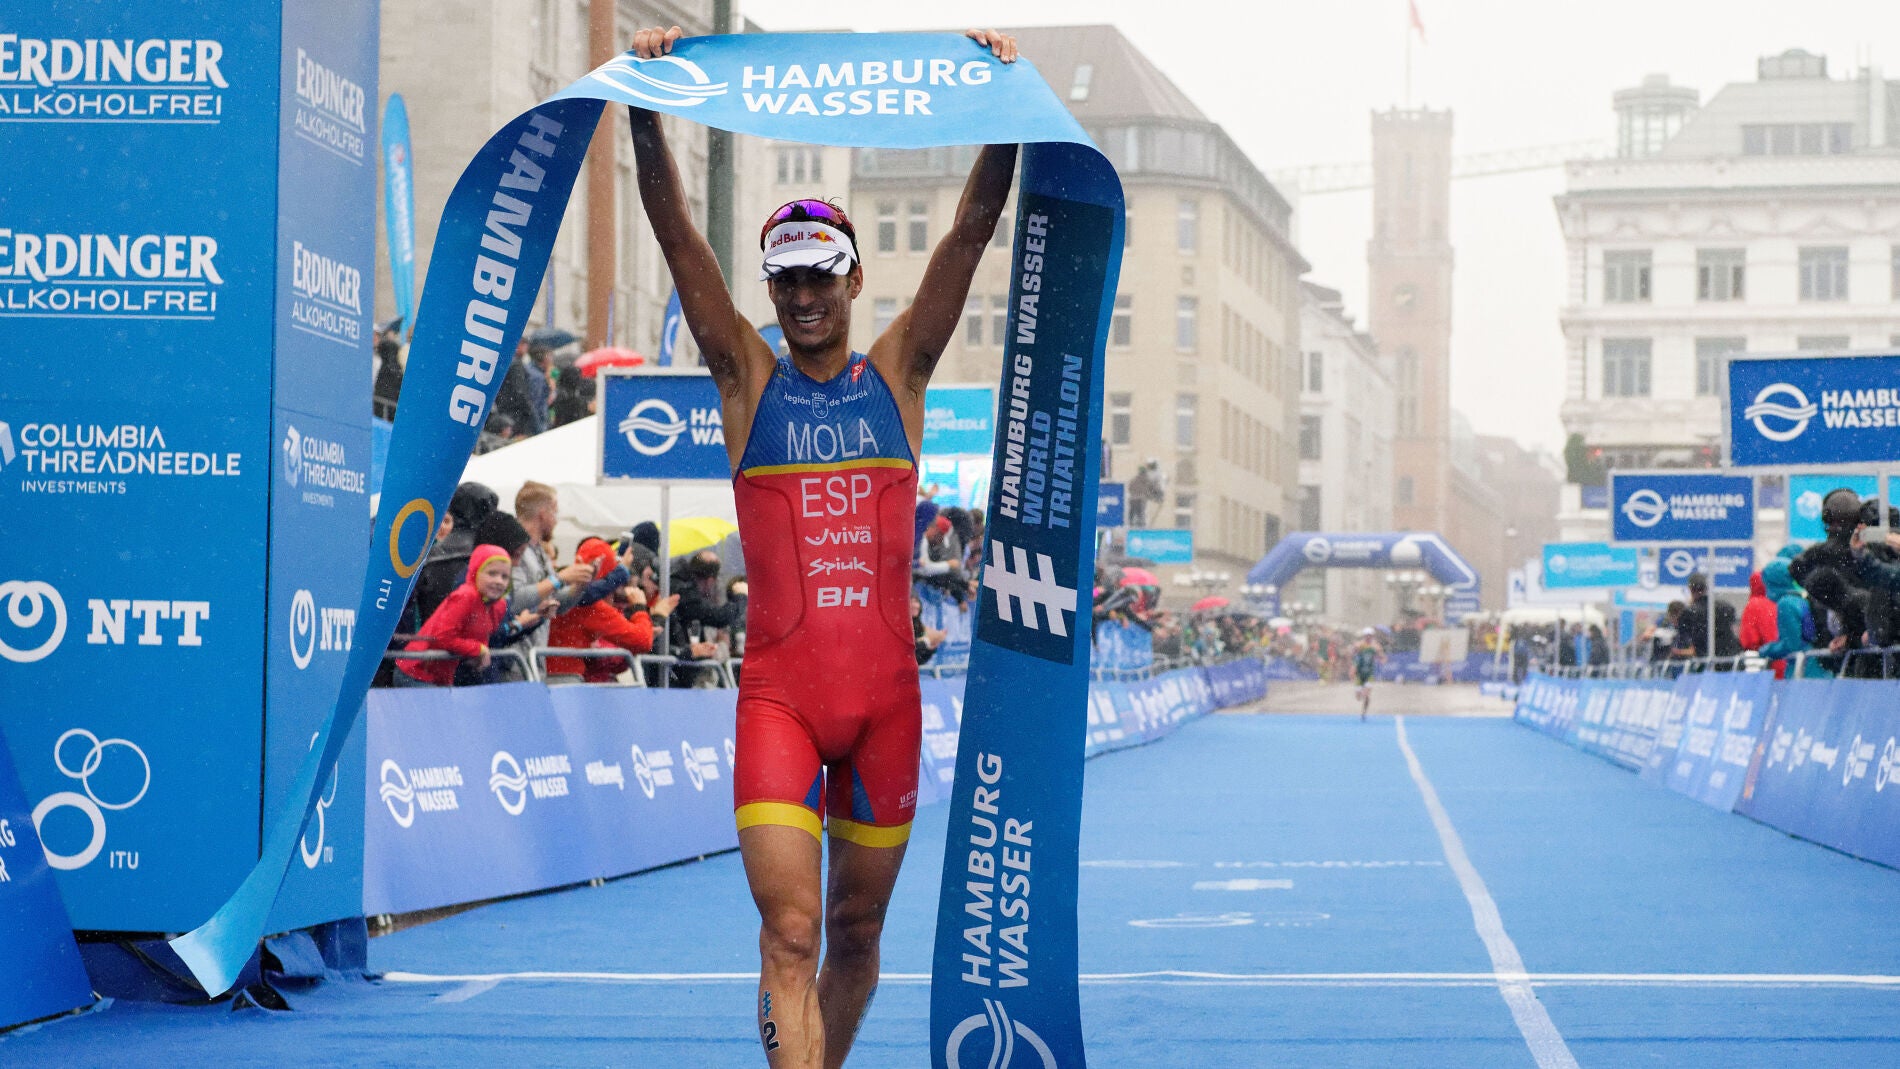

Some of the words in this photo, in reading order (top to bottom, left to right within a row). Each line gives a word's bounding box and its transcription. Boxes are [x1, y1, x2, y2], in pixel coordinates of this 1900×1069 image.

[0, 34, 229, 88] ERDINGER
[742, 59, 992, 89] HAMBURG
[296, 47, 365, 134] ERDINGER
[742, 89, 933, 116] WASSER
[295, 107, 364, 158] ALKOHOLFREI
[783, 231, 804, 243] Bull
[293, 240, 362, 316] ERDINGER
[449, 112, 565, 428] HAMBURG
[1016, 213, 1049, 344] WASSER
[0, 288, 216, 312] LKOHOLFREI
[292, 301, 360, 340] ALKOHOLFREI
[829, 398, 840, 407] de
[1823, 408, 1900, 429] WASSE
[21, 424, 166, 449] COLUMBIA
[302, 435, 346, 467] COLUMBIA
[787, 417, 879, 461] MOLA
[1000, 353, 1033, 520] HAMBURG
[1048, 353, 1083, 529] TRIATHLON
[21, 450, 241, 476] THREADNEEDLE
[302, 461, 365, 494] THREADNEEDLE
[1022, 410, 1052, 525] WORLD
[21, 480, 127, 494] INVESTMENTS
[800, 473, 871, 518] ESP
[1670, 493, 1745, 508] HAMBURG
[1671, 507, 1728, 520] WASSER
[808, 556, 874, 577] Spiuk
[376, 578, 392, 611] ITU
[817, 586, 870, 608] BH
[87, 599, 210, 646] NTT
[320, 607, 355, 651] NTT
[409, 766, 463, 789] HAMBURG
[530, 776, 569, 799] WASSER
[415, 789, 459, 812] WASSER
[109, 851, 139, 870] ITU
[961, 752, 1002, 987] HAMBURG
[998, 817, 1033, 989] WASSER
[763, 1021, 780, 1052] 2
